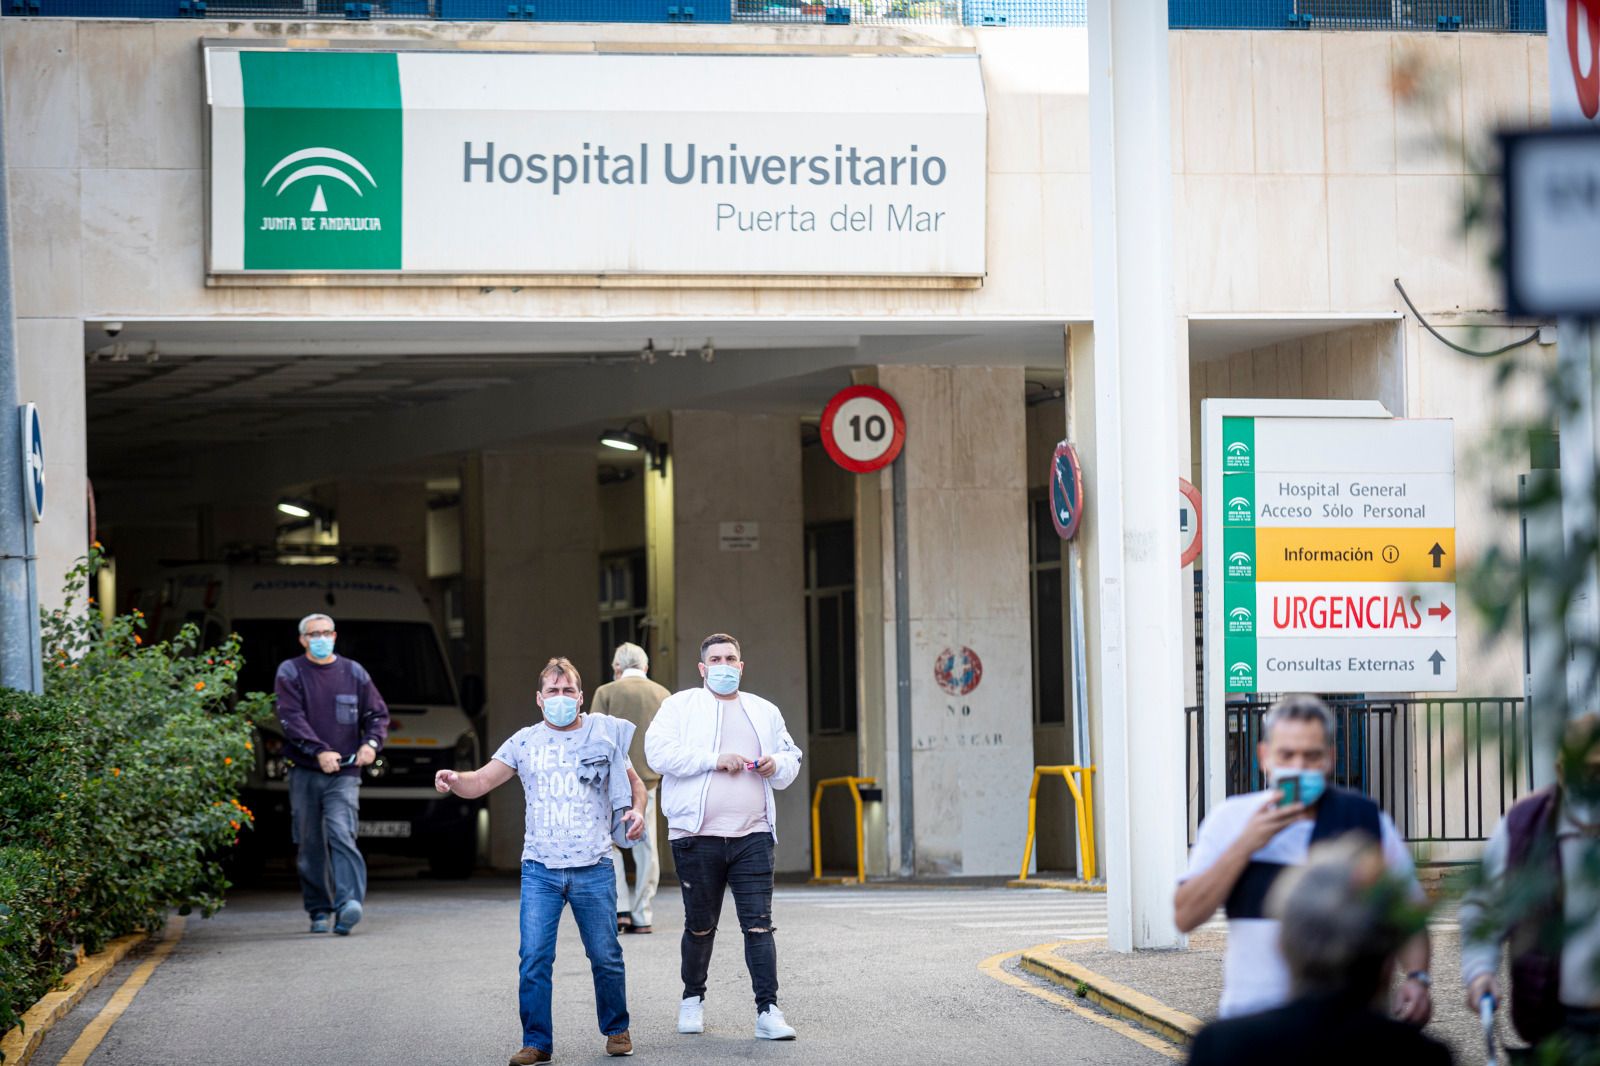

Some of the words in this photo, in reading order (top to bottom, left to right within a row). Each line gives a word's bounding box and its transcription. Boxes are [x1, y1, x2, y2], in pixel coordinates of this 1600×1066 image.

[463, 141, 648, 195] Hospital
[664, 142, 947, 186] Universitario
[260, 217, 297, 230] JUNTA
[301, 217, 316, 230] DE
[717, 203, 815, 232] Puerta
[830, 203, 873, 232] del
[887, 203, 946, 232] Mar
[849, 416, 887, 442] 10
[1279, 482, 1340, 498] Hospital
[1349, 482, 1406, 497] General
[1261, 504, 1313, 518] Acceso
[1322, 502, 1354, 518] Sólo
[1363, 504, 1426, 518] Personal
[1284, 547, 1373, 562] Información
[1272, 596, 1422, 630] URGENCIAS
[1266, 657, 1342, 672] Consultas
[1348, 657, 1415, 672] Externas
[946, 704, 971, 717] NO
